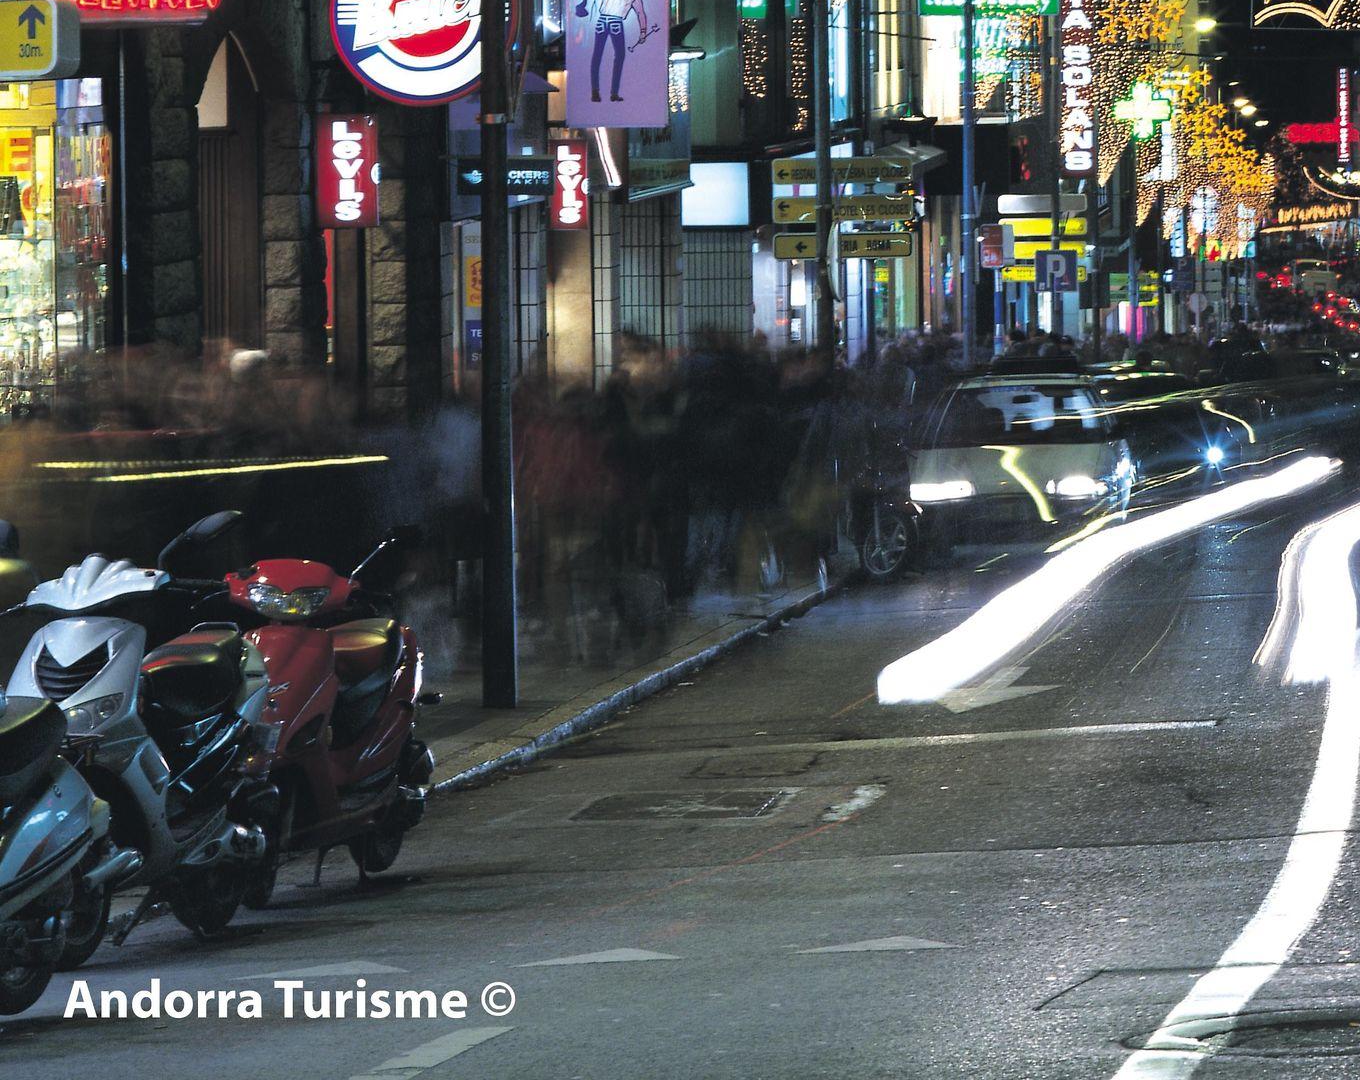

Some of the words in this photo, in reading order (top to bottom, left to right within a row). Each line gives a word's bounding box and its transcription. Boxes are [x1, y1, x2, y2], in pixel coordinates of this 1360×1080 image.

[18, 43, 43, 58] 30m.
[1061, 45, 1094, 172] SOLANS
[508, 170, 549, 179] CKERS
[1046, 254, 1066, 290] P
